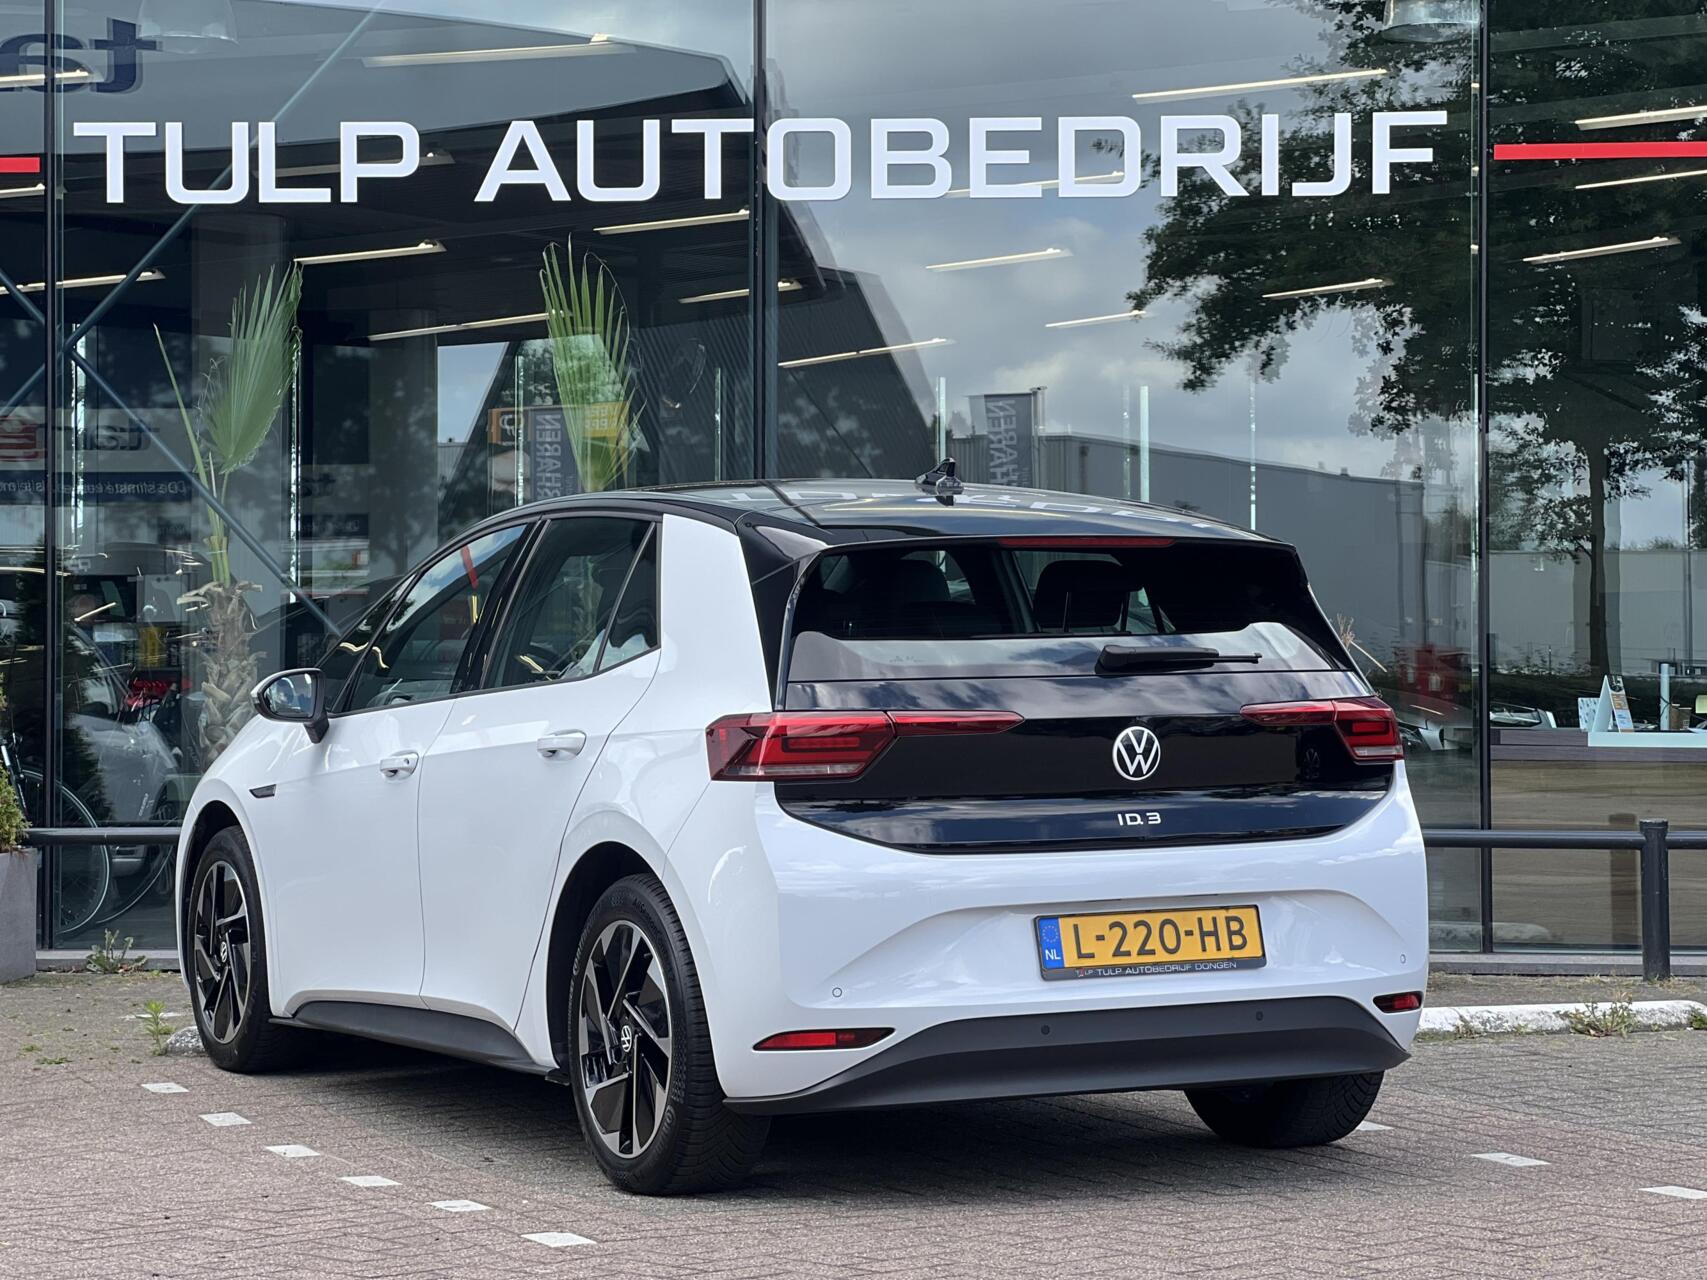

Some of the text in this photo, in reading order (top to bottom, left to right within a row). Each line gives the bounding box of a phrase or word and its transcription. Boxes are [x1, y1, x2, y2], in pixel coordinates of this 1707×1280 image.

[74, 110, 1448, 204] TULP AUTOBEDRIJF
[1073, 915, 1248, 960] L-220-HB
[1045, 949, 1062, 961] NL
[1097, 961, 1237, 976] TULP AUTOBEDRIJF DONGEN
